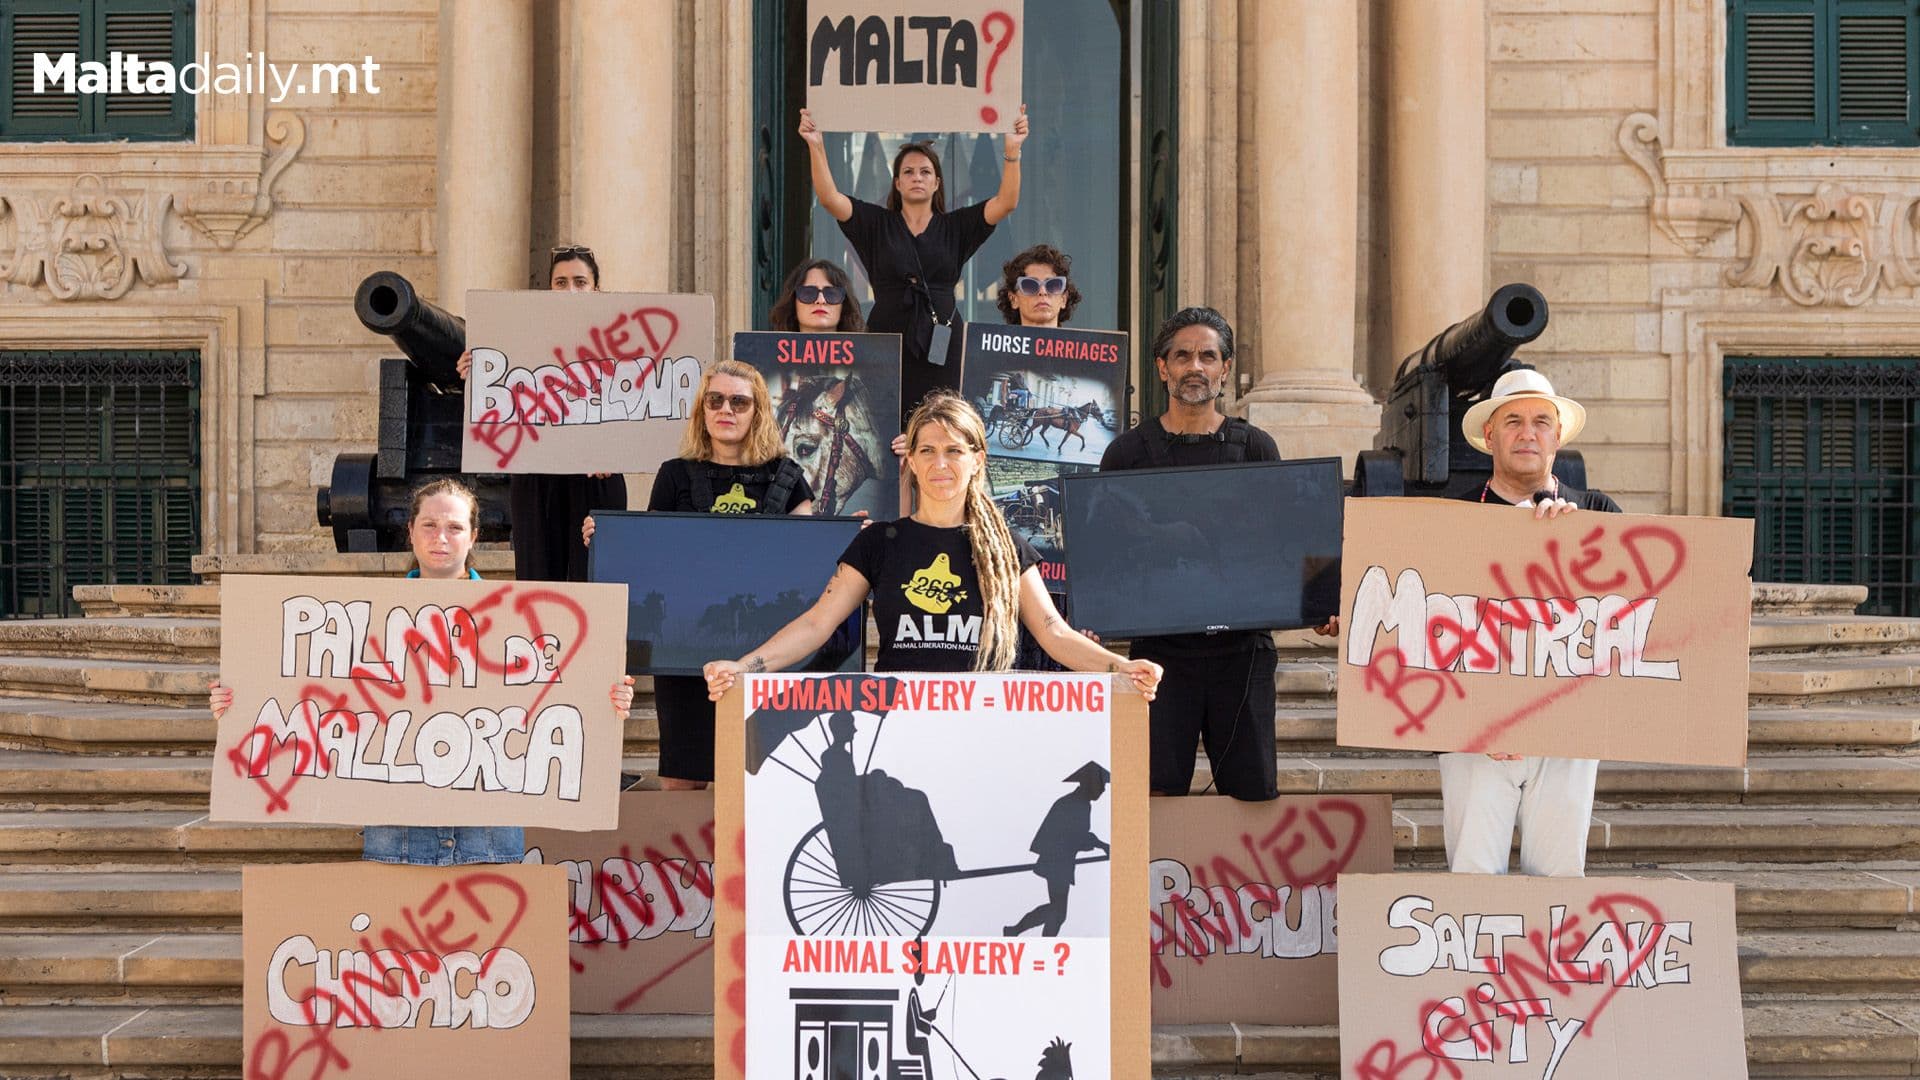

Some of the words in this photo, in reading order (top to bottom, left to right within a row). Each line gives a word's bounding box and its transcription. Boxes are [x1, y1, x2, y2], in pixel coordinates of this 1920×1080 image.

[471, 348, 701, 425] BARCELONA
[471, 307, 679, 468] BANNED
[777, 339, 855, 365] SLAVES
[982, 333, 1031, 355] HORSE
[1035, 338, 1118, 363] CARRIAGES
[281, 595, 478, 688] PALMA
[504, 634, 562, 685] DE
[893, 642, 918, 650] ANIMAL
[918, 642, 957, 651] LIBERATION
[895, 614, 983, 643] ALM
[1347, 565, 1681, 681] MONTREAL
[1365, 524, 1686, 737] BANNED
[228, 584, 588, 814] BANNED
[751, 680, 853, 711] HUMAN
[860, 680, 976, 711] SLAVERY
[1003, 681, 1105, 712] WRONG
[248, 697, 585, 801] MALLORCA
[783, 939, 894, 973] ANIMAL
[902, 941, 1025, 976] SLAVERY
[1053, 943, 1071, 976] ?
[1379, 895, 1525, 976] SALT
[1548, 905, 1692, 989] LAKE
